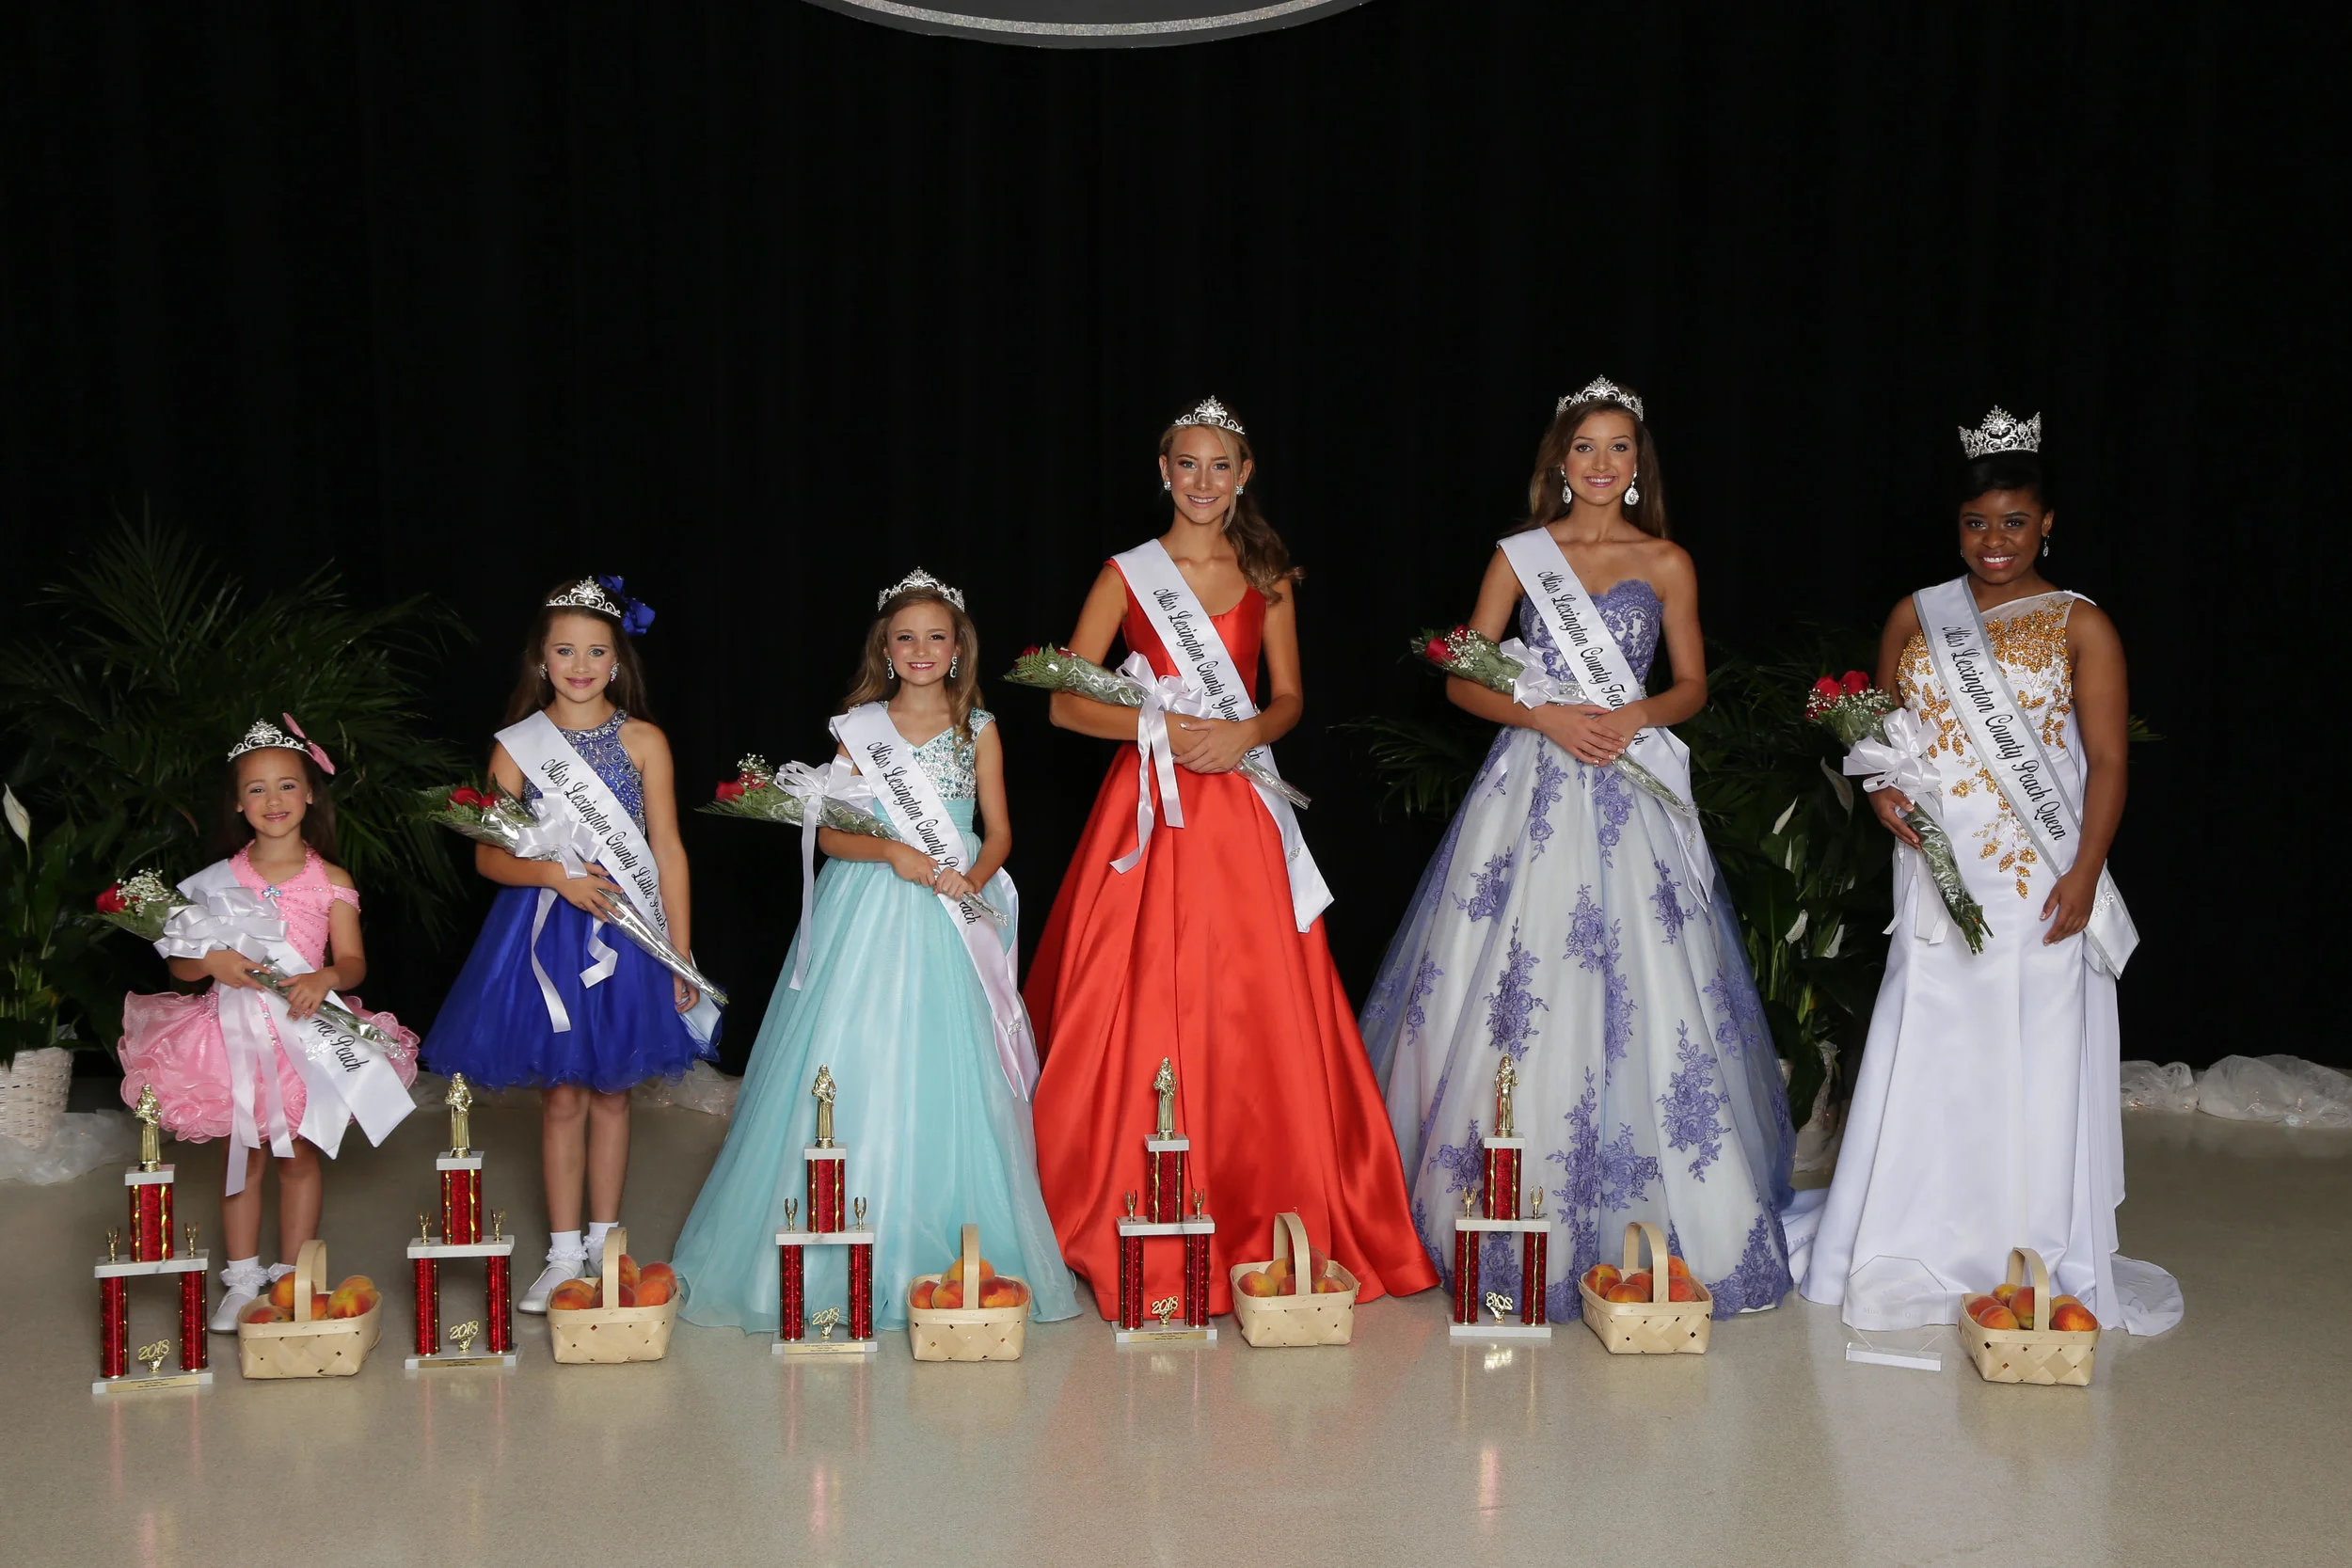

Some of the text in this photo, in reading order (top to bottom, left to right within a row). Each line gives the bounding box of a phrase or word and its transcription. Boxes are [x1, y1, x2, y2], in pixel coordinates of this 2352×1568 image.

[1152, 588, 1239, 721] Miss Lexington County Youn
[1537, 571, 1627, 707] Miss Lexington County Tee
[1942, 625, 2067, 841] Miss Lexington County Peach Queen
[866, 741, 948, 857] Miss Lexington County
[540, 758, 570, 787] Miss
[564, 781, 612, 836] Lexington
[605, 831, 638, 872] County
[631, 866, 658, 899] Little
[959, 900, 981, 926] each
[329, 1035, 370, 1073] Peach
[812, 1307, 840, 1325] 2018
[1152, 1295, 1179, 1315] 2018
[137, 1338, 170, 1360] 2018
[449, 1320, 479, 1340] 2018
